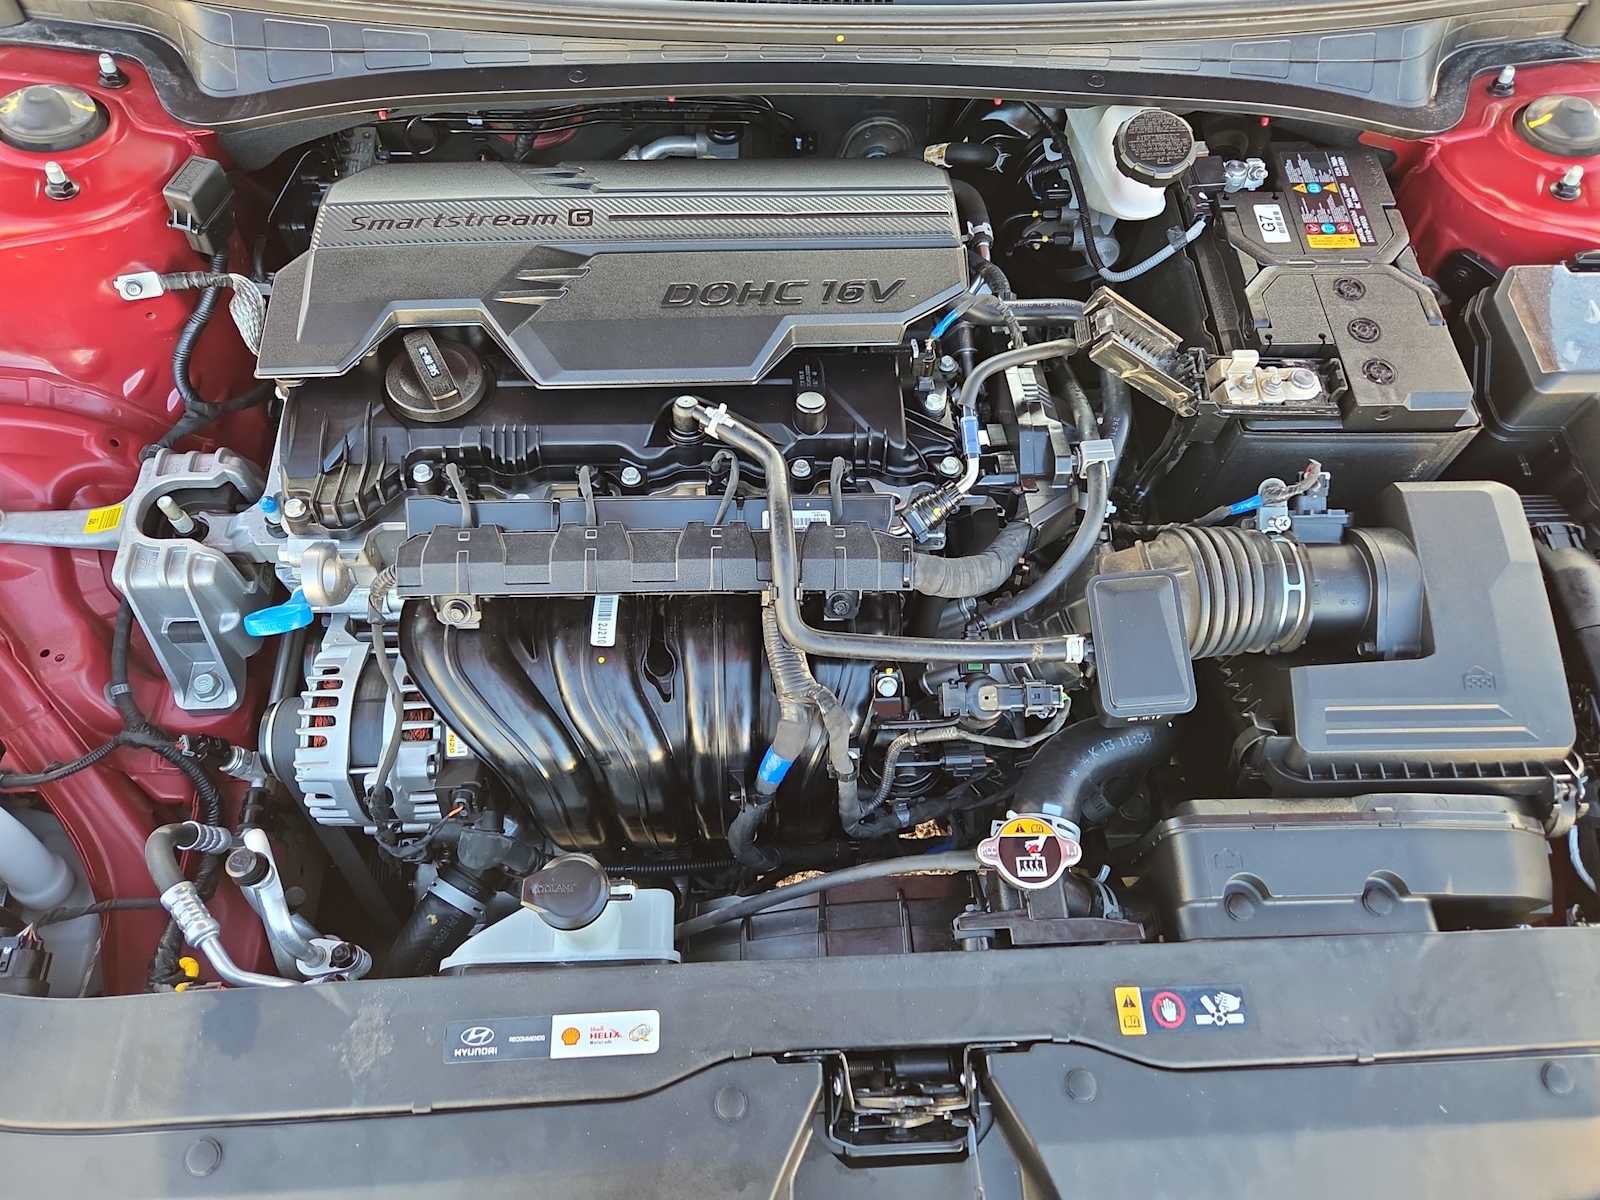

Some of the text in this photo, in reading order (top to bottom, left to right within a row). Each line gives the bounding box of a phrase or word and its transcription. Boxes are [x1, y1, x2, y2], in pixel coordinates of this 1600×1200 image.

[346, 210, 592, 231] Smartstream G
[1259, 214, 1276, 232] G7
[661, 278, 906, 307] DOHC 16V
[590, 1029, 621, 1039] HELIX
[454, 1047, 497, 1057] HYUNDAI
